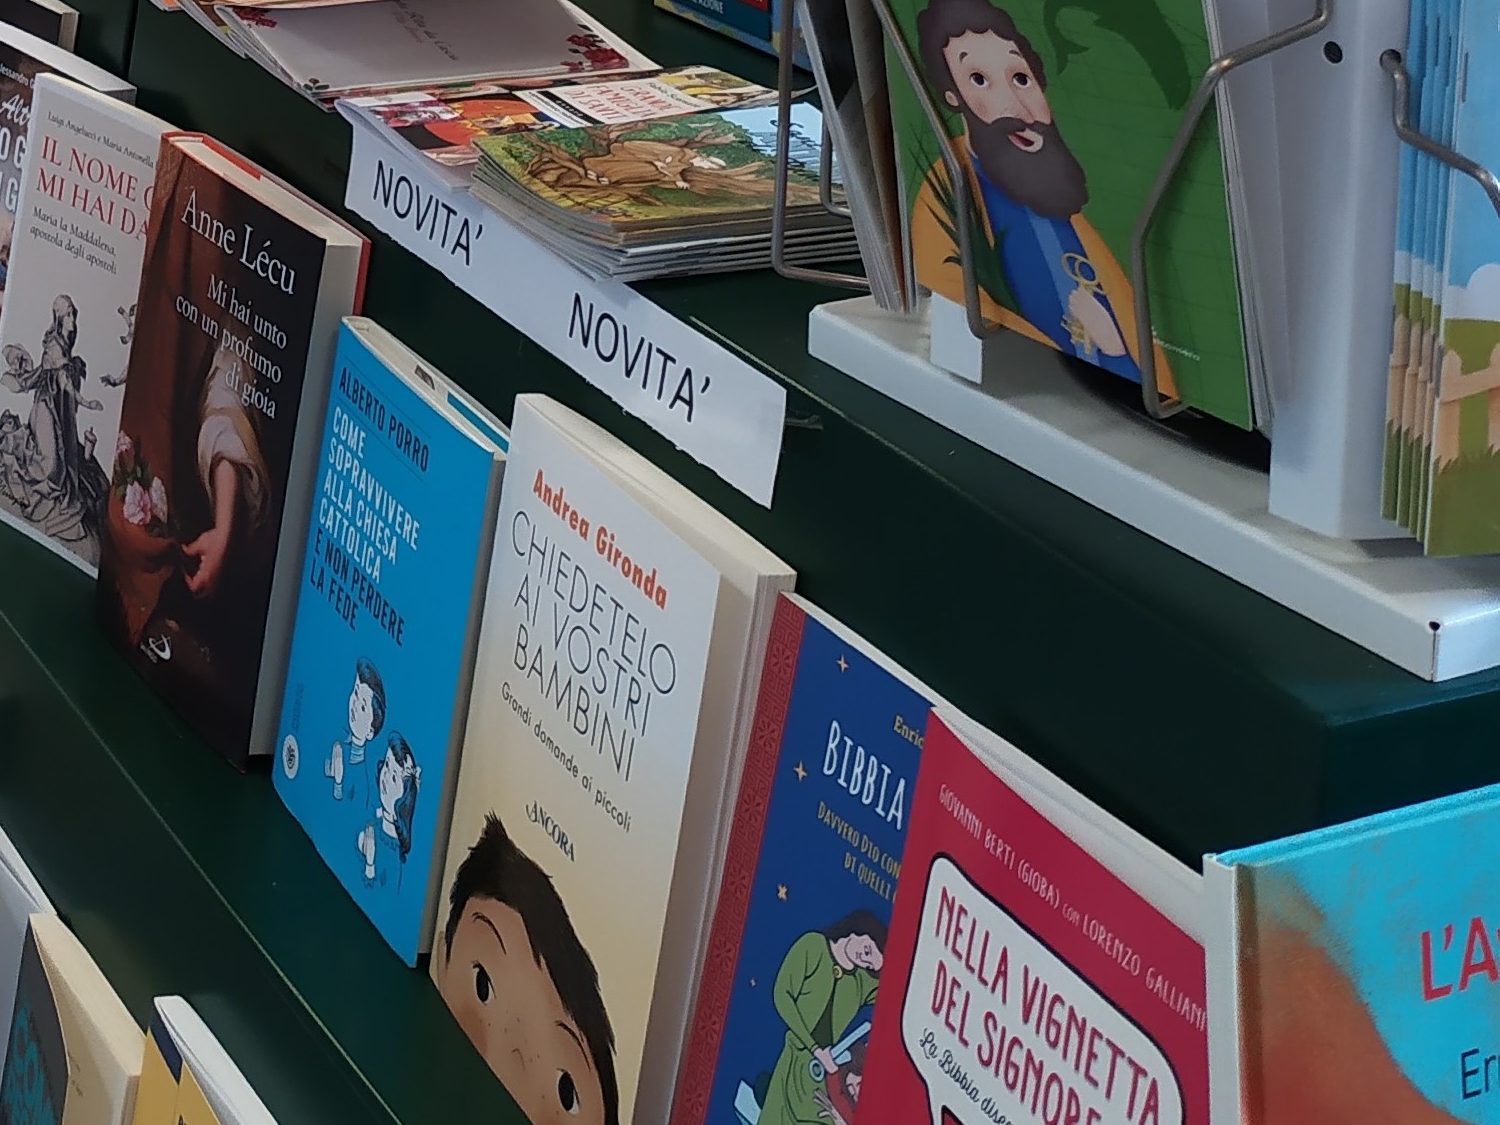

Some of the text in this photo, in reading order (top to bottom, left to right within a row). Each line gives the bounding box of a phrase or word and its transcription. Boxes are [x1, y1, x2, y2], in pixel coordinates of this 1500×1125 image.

[42, 135, 138, 203] IL NOME
[48, 111, 154, 169] Luigi Angelucci Maria Antonella
[33, 206, 116, 256] Maria la Maddalena,
[36, 168, 114, 226] MI HAI
[181, 189, 295, 294] Anne Lécu
[30, 226, 117, 275] apostola degli apostoli
[373, 160, 711, 423] NOVITA' NOVITA'
[176, 295, 282, 383] con un profumo
[207, 274, 287, 350] Mi hai unto
[226, 363, 276, 419] di gioia
[333, 406, 366, 459] COME
[339, 367, 430, 473] ALBERTO PORRO
[324, 469, 397, 565] ALLA CHIESA
[329, 437, 420, 551] SOPRAVVIVERE
[532, 468, 668, 610] Andrea Gironda
[319, 497, 382, 584] CATTOLICA
[310, 558, 359, 631] LA FEDE
[315, 528, 405, 647] E NON PERDERE
[512, 510, 676, 695] CHIEDETELO
[514, 573, 651, 737] AI VOSTRI
[513, 623, 635, 782] BAMBINI
[501, 680, 631, 833] Grandi domande ai piccoli
[823, 719, 907, 831] BIBBIA
[526, 799, 575, 863] ANCORA
[817, 800, 879, 861] DAVVERO DIO
[844, 851, 890, 903] DI QUELLI
[939, 783, 1142, 977] GIOVANNI BERTI (GIOBA) LORENZO
[931, 958, 971, 1050] DEL
[934, 885, 1161, 1125] NELLA VIGNETTA
[918, 1027, 980, 1105] La Bibbia
